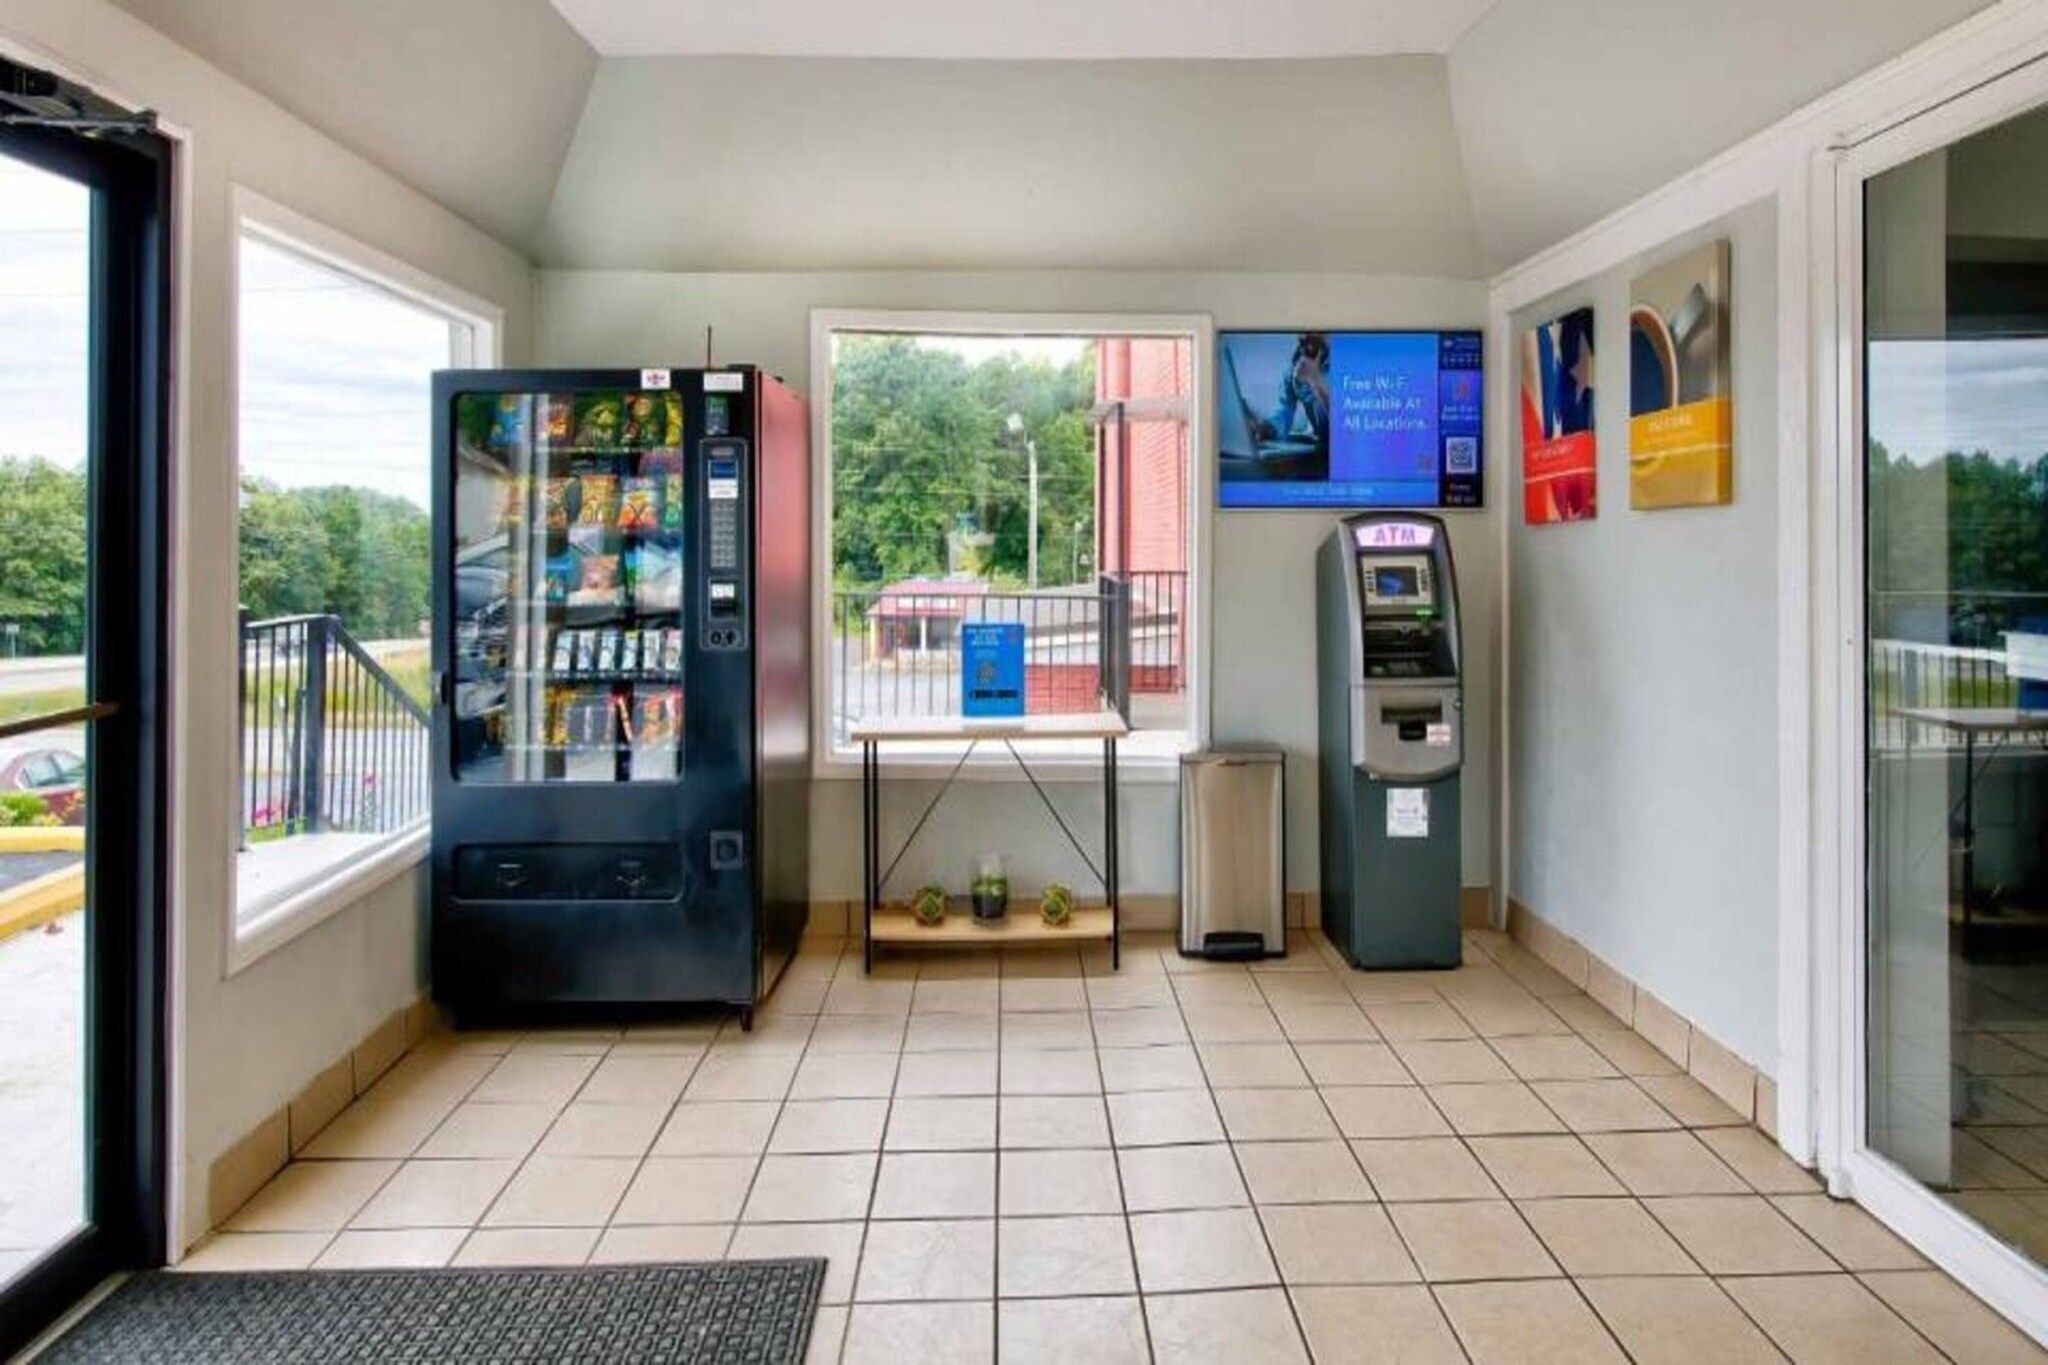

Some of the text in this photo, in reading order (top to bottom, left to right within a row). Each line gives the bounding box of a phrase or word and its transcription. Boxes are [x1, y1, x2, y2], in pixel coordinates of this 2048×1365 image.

[1343, 375, 1371, 391] Free
[1343, 396, 1402, 411] Available
[1343, 415, 1361, 430] All
[1374, 525, 1416, 544] ATM
